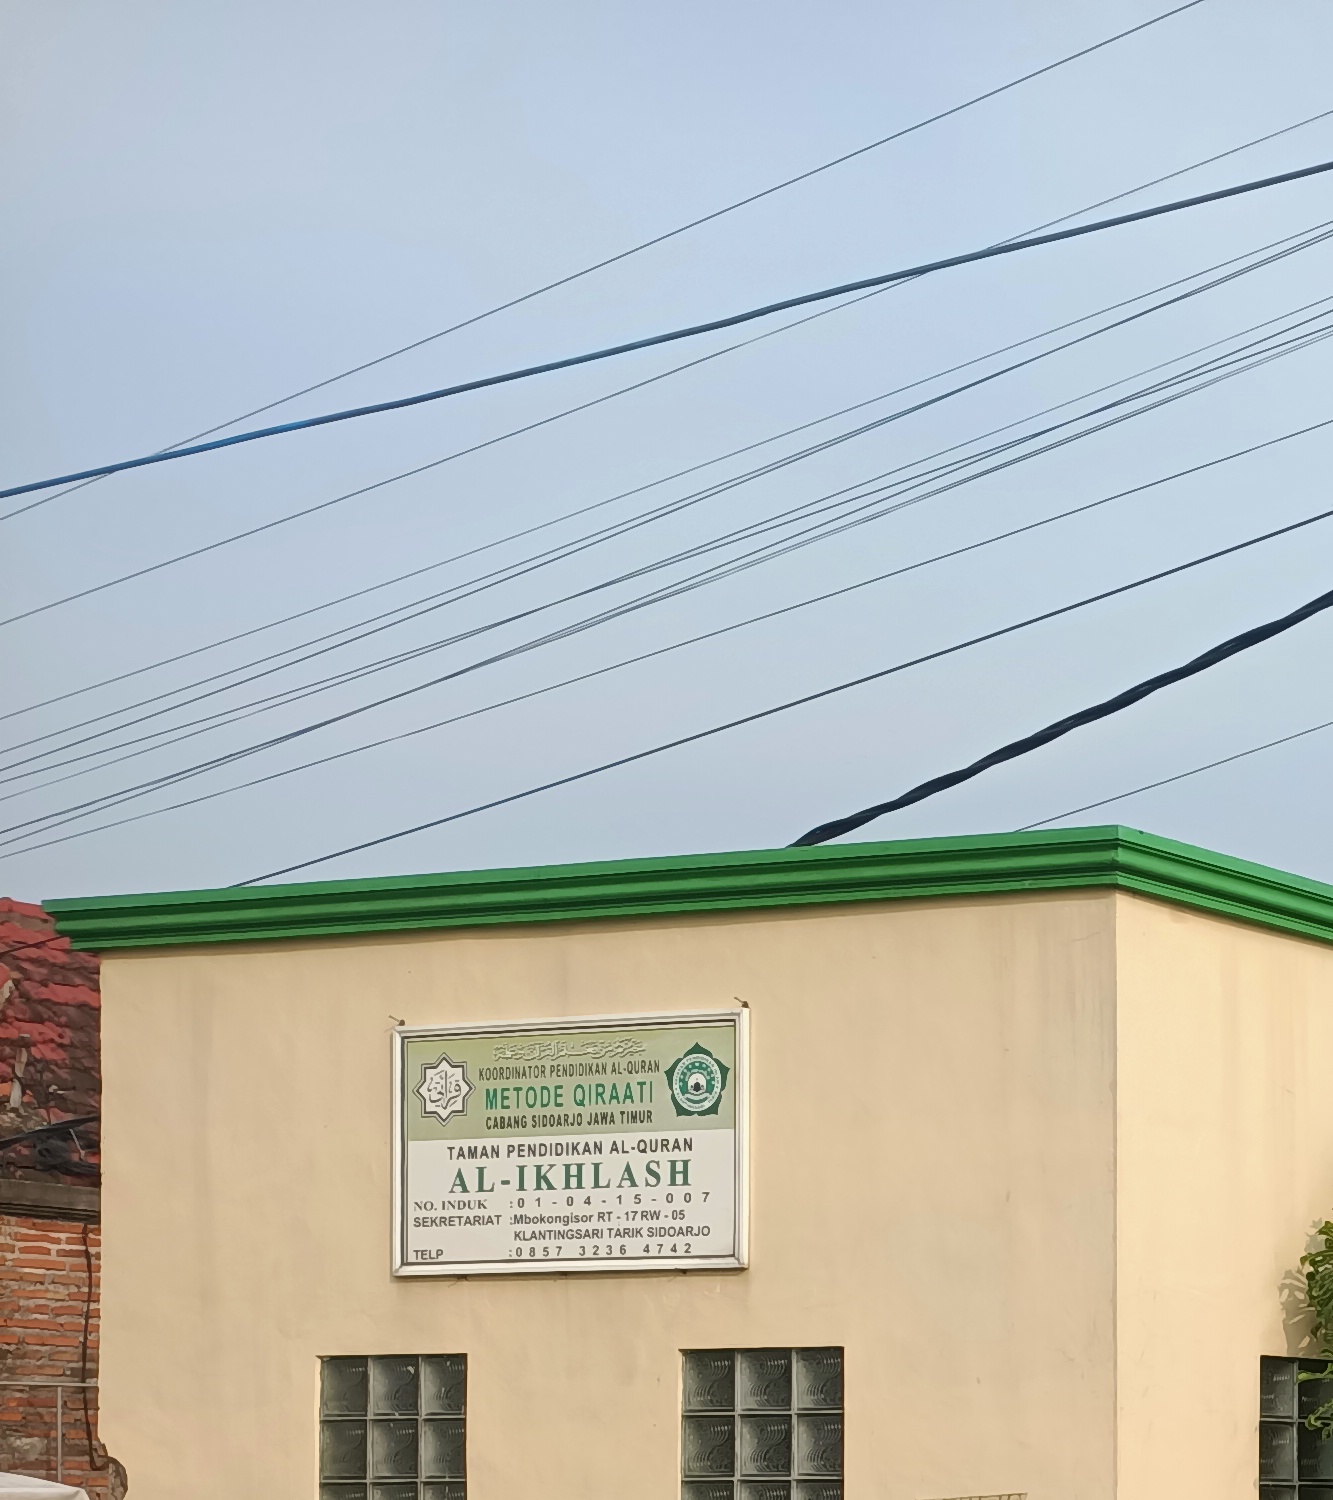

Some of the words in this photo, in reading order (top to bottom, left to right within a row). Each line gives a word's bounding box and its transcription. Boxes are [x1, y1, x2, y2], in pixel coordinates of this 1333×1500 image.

[478, 1064, 546, 1082] KOORDINATOR
[549, 1062, 608, 1078] PENDIDIKAN
[610, 1060, 660, 1075] AL-QURAN
[485, 1085, 564, 1110] METODE
[572, 1081, 654, 1107] QIRAATI
[485, 1114, 528, 1130] CABANG
[531, 1112, 584, 1128] SIDOARJO
[587, 1111, 616, 1126] JAWA
[620, 1109, 653, 1124] TIMUR
[447, 1145, 500, 1161] TAMAN
[506, 1141, 603, 1158] PENDIDIKAN
[609, 1137, 694, 1155] AL-QURAN
[448, 1159, 692, 1194] AL-IKHLASH
[413, 1200, 438, 1211] NO.
[441, 1199, 488, 1211] INDUK
[413, 1214, 502, 1228] SEKRETARIAT
[597, 1211, 613, 1223] RT
[624, 1211, 638, 1222] 17
[640, 1209, 661, 1222] RW
[671, 1209, 686, 1221] 05
[513, 1228, 604, 1241] KLANTINGSARI
[606, 1227, 643, 1240] TARIK
[646, 1225, 711, 1238] SIDOARJO
[413, 1249, 444, 1261] TELP
[578, 1244, 627, 1257] 3236
[643, 1242, 693, 1255] 4742
